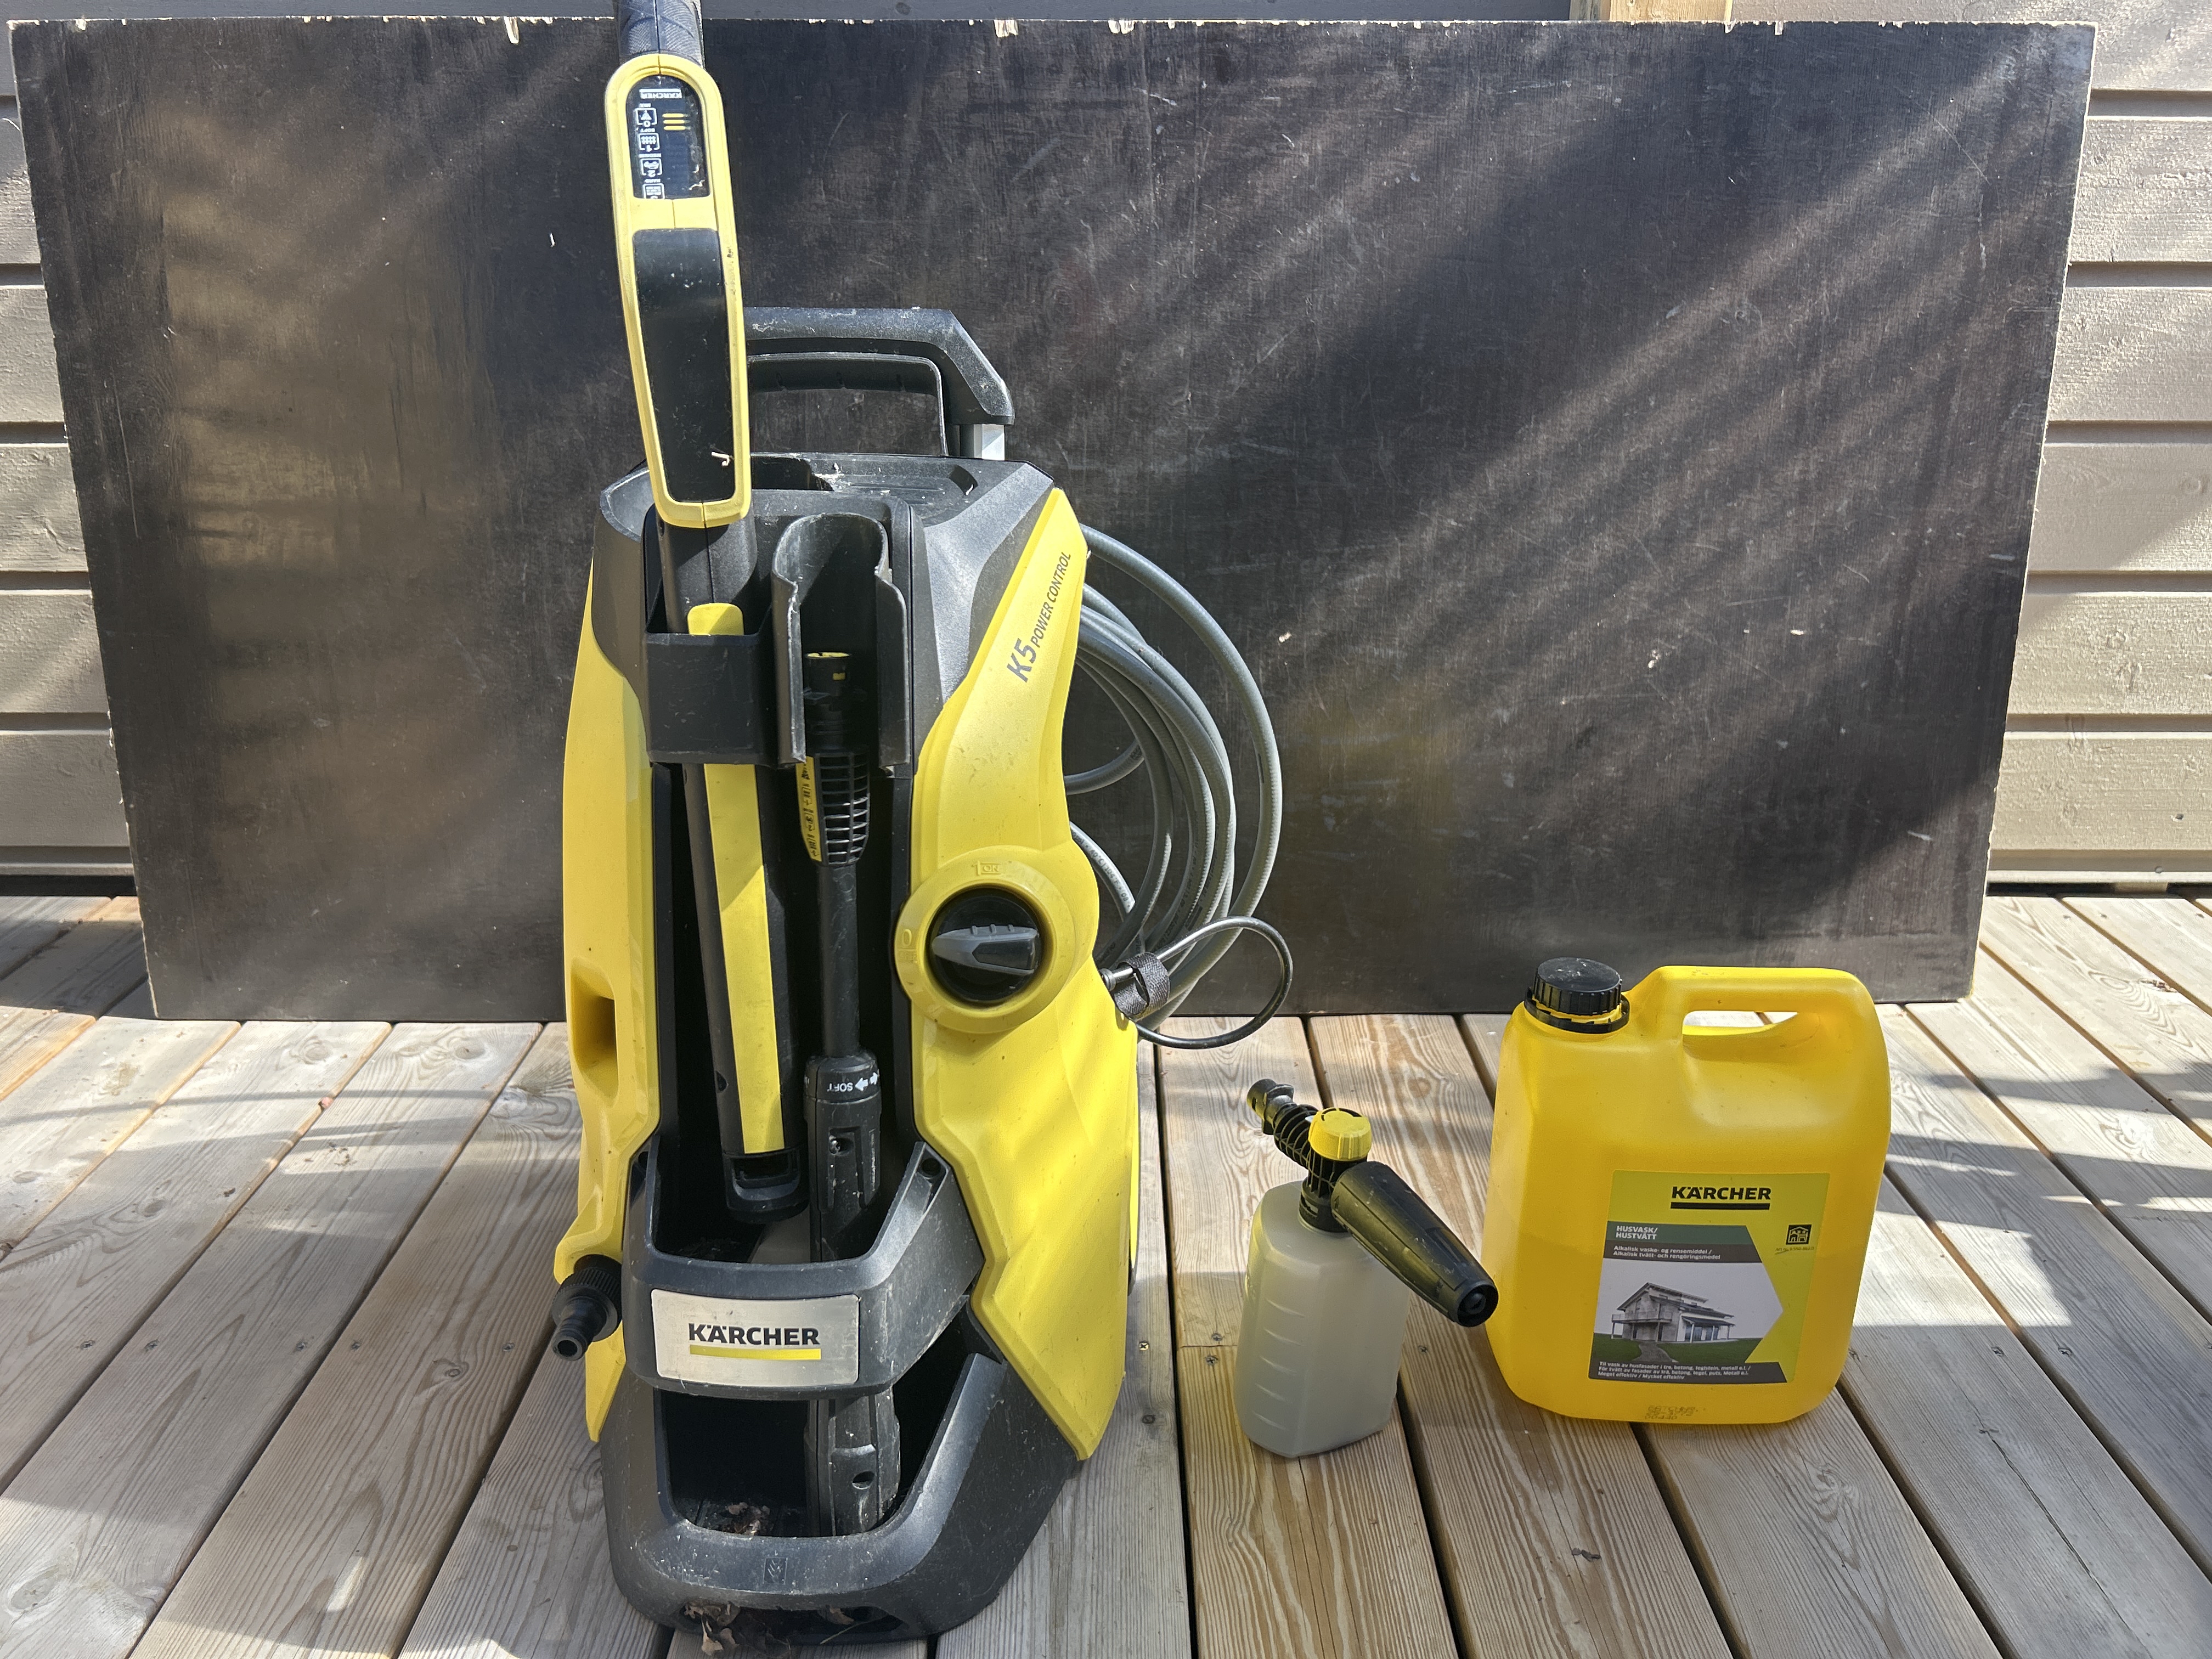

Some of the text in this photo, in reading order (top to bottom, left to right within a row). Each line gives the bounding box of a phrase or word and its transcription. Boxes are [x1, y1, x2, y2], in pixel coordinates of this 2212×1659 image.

[647, 170, 656, 178] 2
[1006, 551, 1071, 683] K5 POWER CONTROL
[983, 864, 999, 872] ON
[827, 1082, 854, 1092] SOFT
[1672, 1186, 1771, 1200] KÄRCHER
[1616, 1225, 1657, 1234] HUSVASK/
[1616, 1232, 1657, 1240] HUSTVÄTT
[689, 1323, 821, 1346] KÄRCHER
